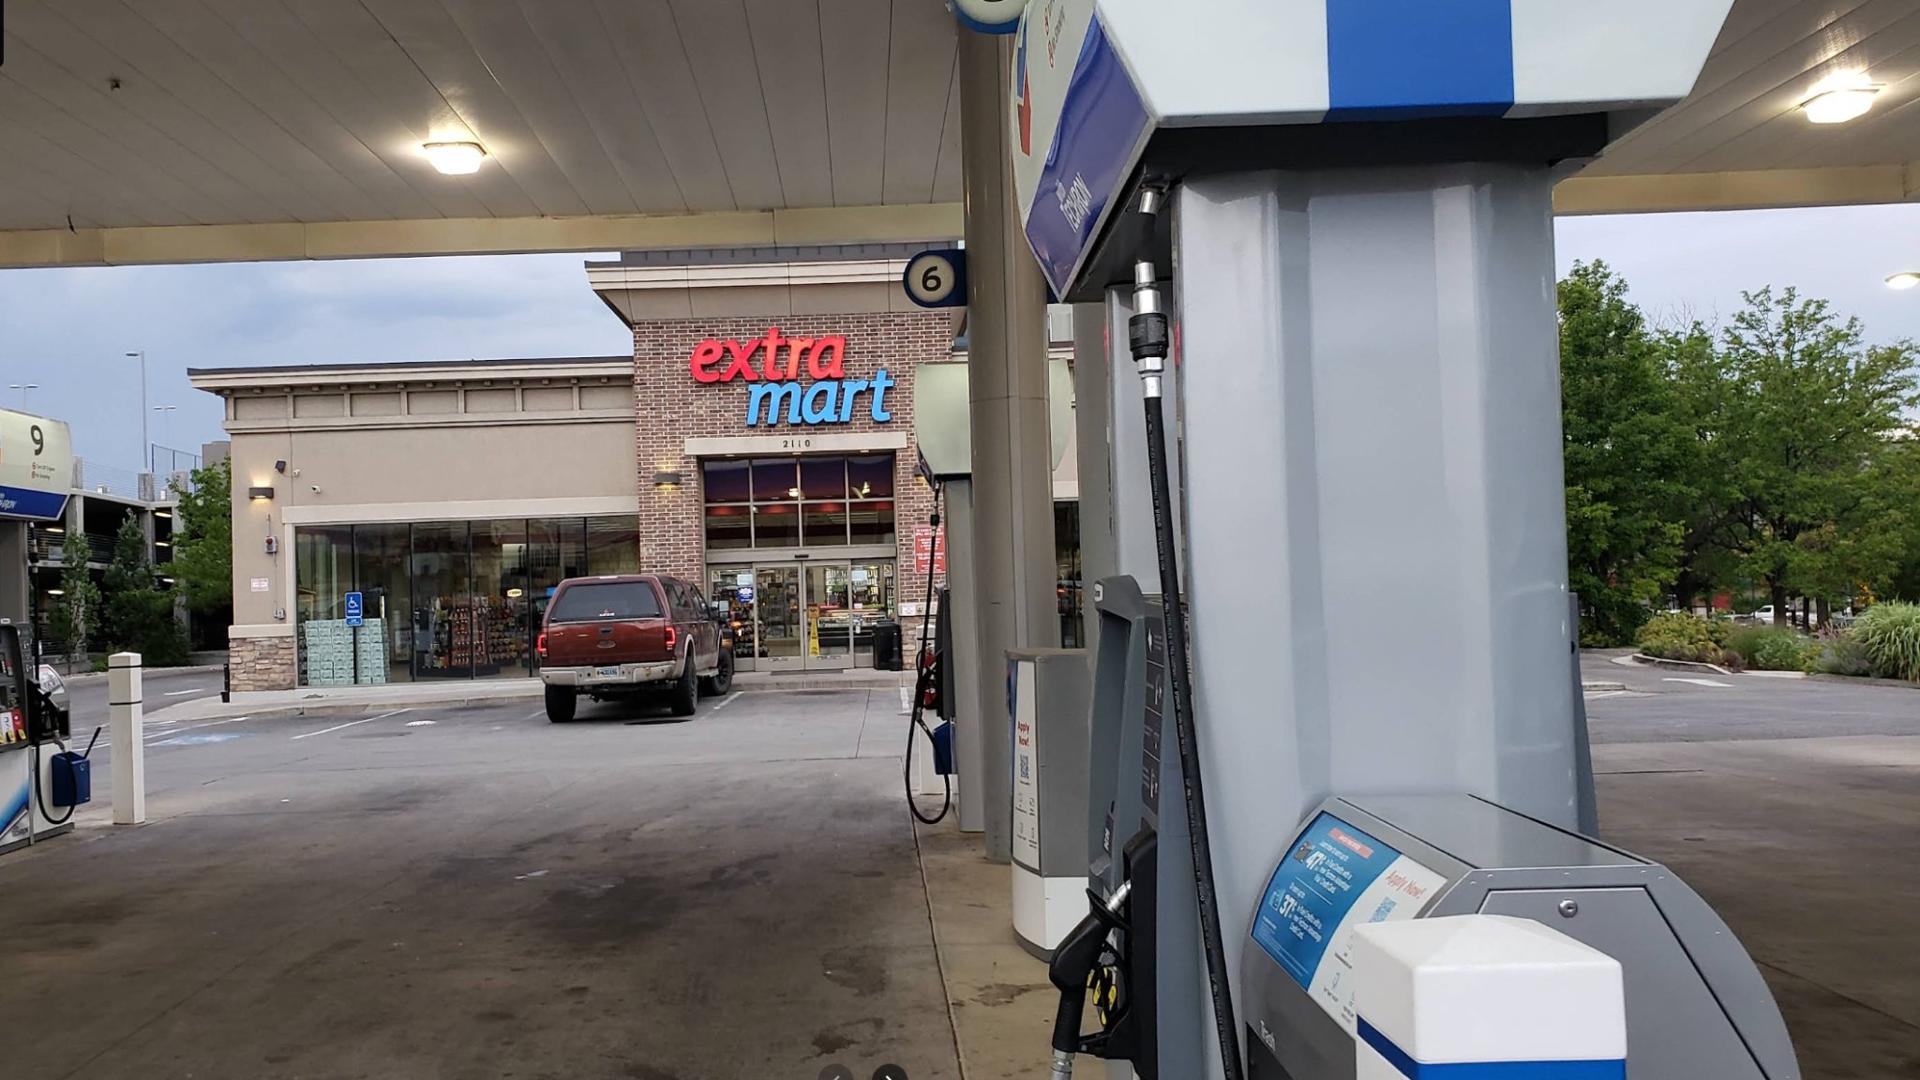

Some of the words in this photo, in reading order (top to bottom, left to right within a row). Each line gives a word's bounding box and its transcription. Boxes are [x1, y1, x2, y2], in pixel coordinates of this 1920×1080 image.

[921, 265, 942, 292] 6
[690, 326, 847, 384] extra
[745, 369, 895, 428] mart
[30, 424, 44, 456] 9
[782, 438, 811, 448] 2110
